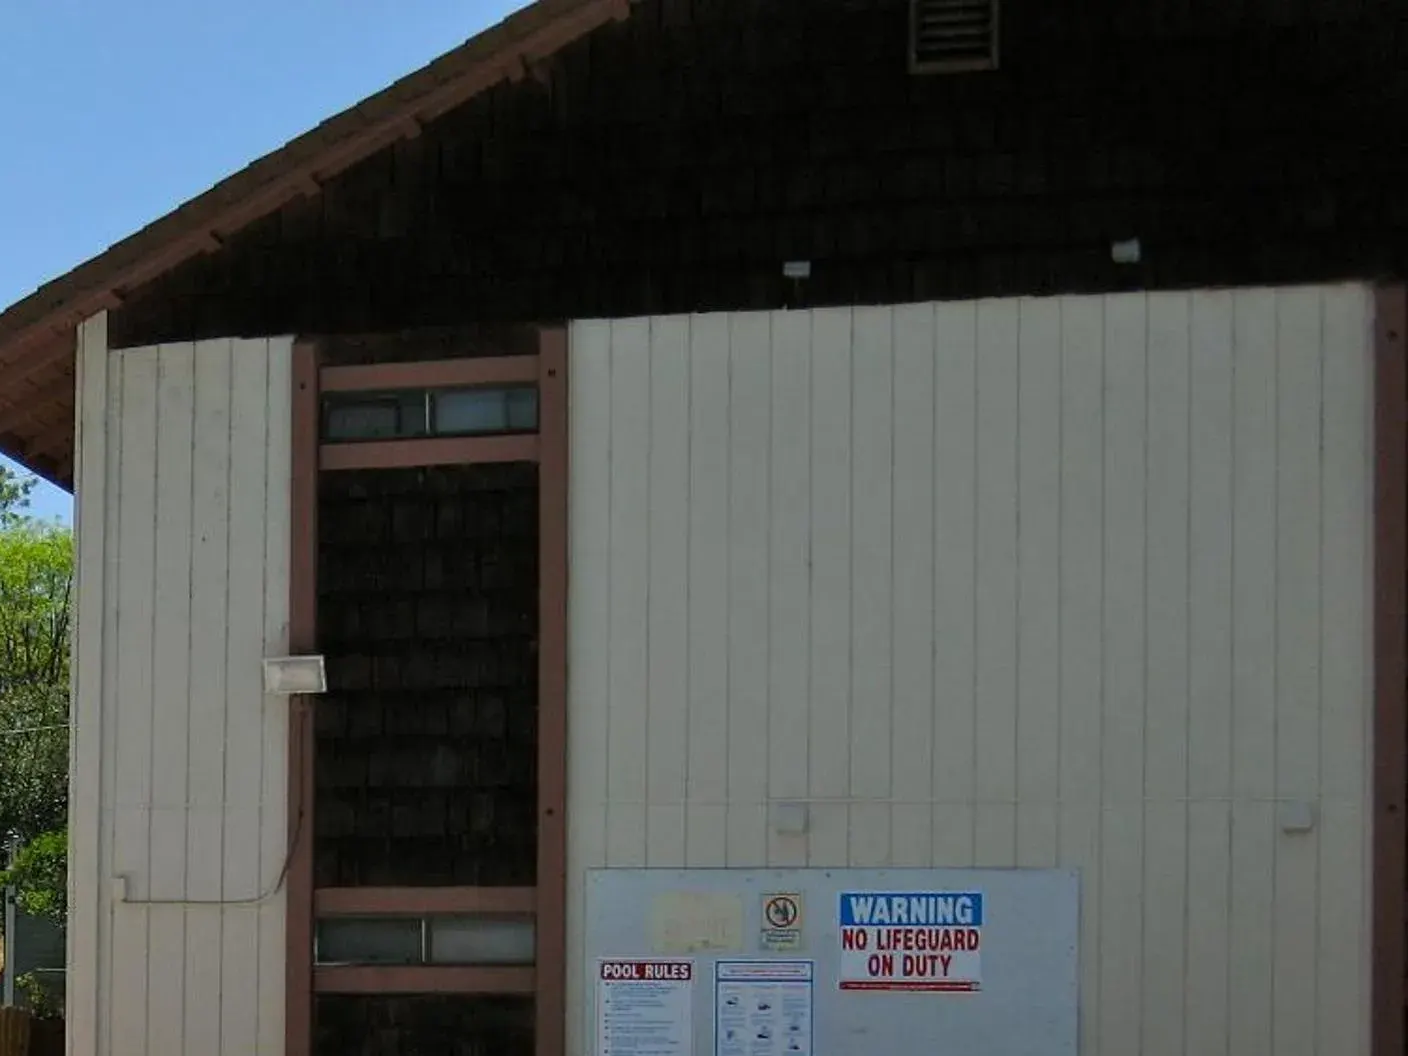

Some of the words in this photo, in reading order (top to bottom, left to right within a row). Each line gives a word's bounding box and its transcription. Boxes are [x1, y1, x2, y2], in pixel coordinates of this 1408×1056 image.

[850, 896, 973, 924] WARNING
[842, 929, 868, 950] NO
[876, 929, 979, 951] LIFEGUARD
[603, 964, 639, 978] POOL
[645, 964, 689, 978] RULES
[868, 954, 893, 976] ON
[902, 955, 952, 977] DUTY
